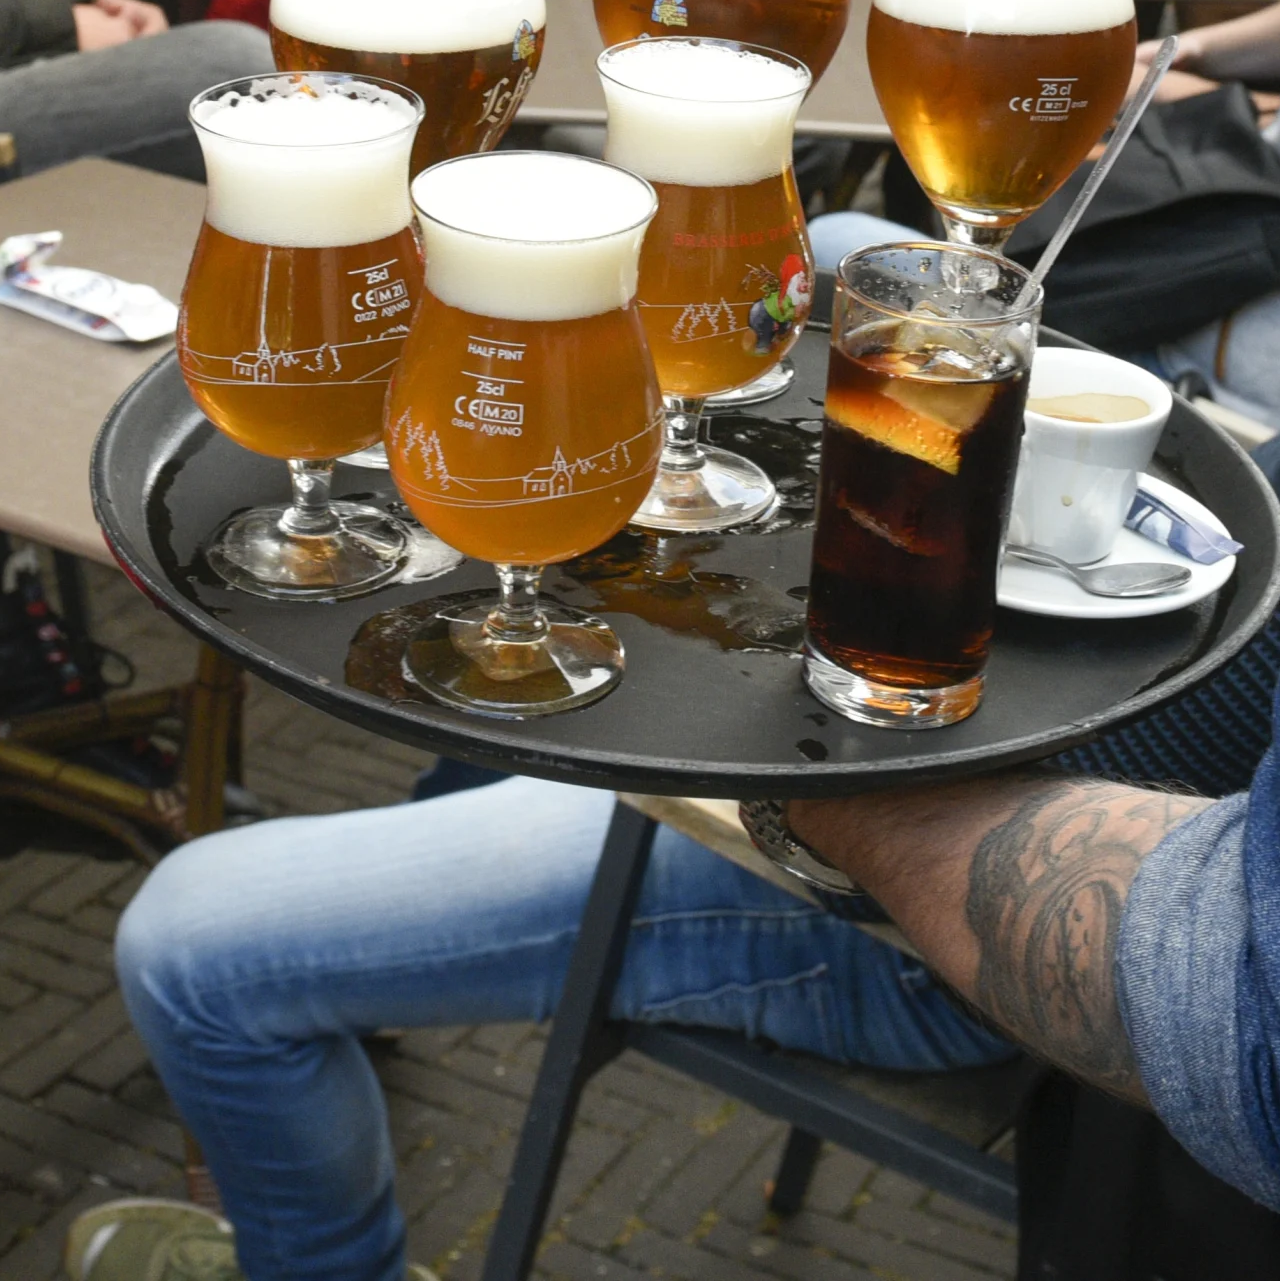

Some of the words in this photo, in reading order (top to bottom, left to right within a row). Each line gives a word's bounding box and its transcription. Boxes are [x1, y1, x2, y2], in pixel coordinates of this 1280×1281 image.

[1040, 83, 1058, 96] 25
[1059, 83, 1072, 96] cl
[673, 232, 765, 249] BRASSERIE
[365, 267, 390, 285] 25cl
[467, 342, 497, 358] HALF
[497, 349, 525, 361] PINT
[476, 380, 505, 397] 25cl
